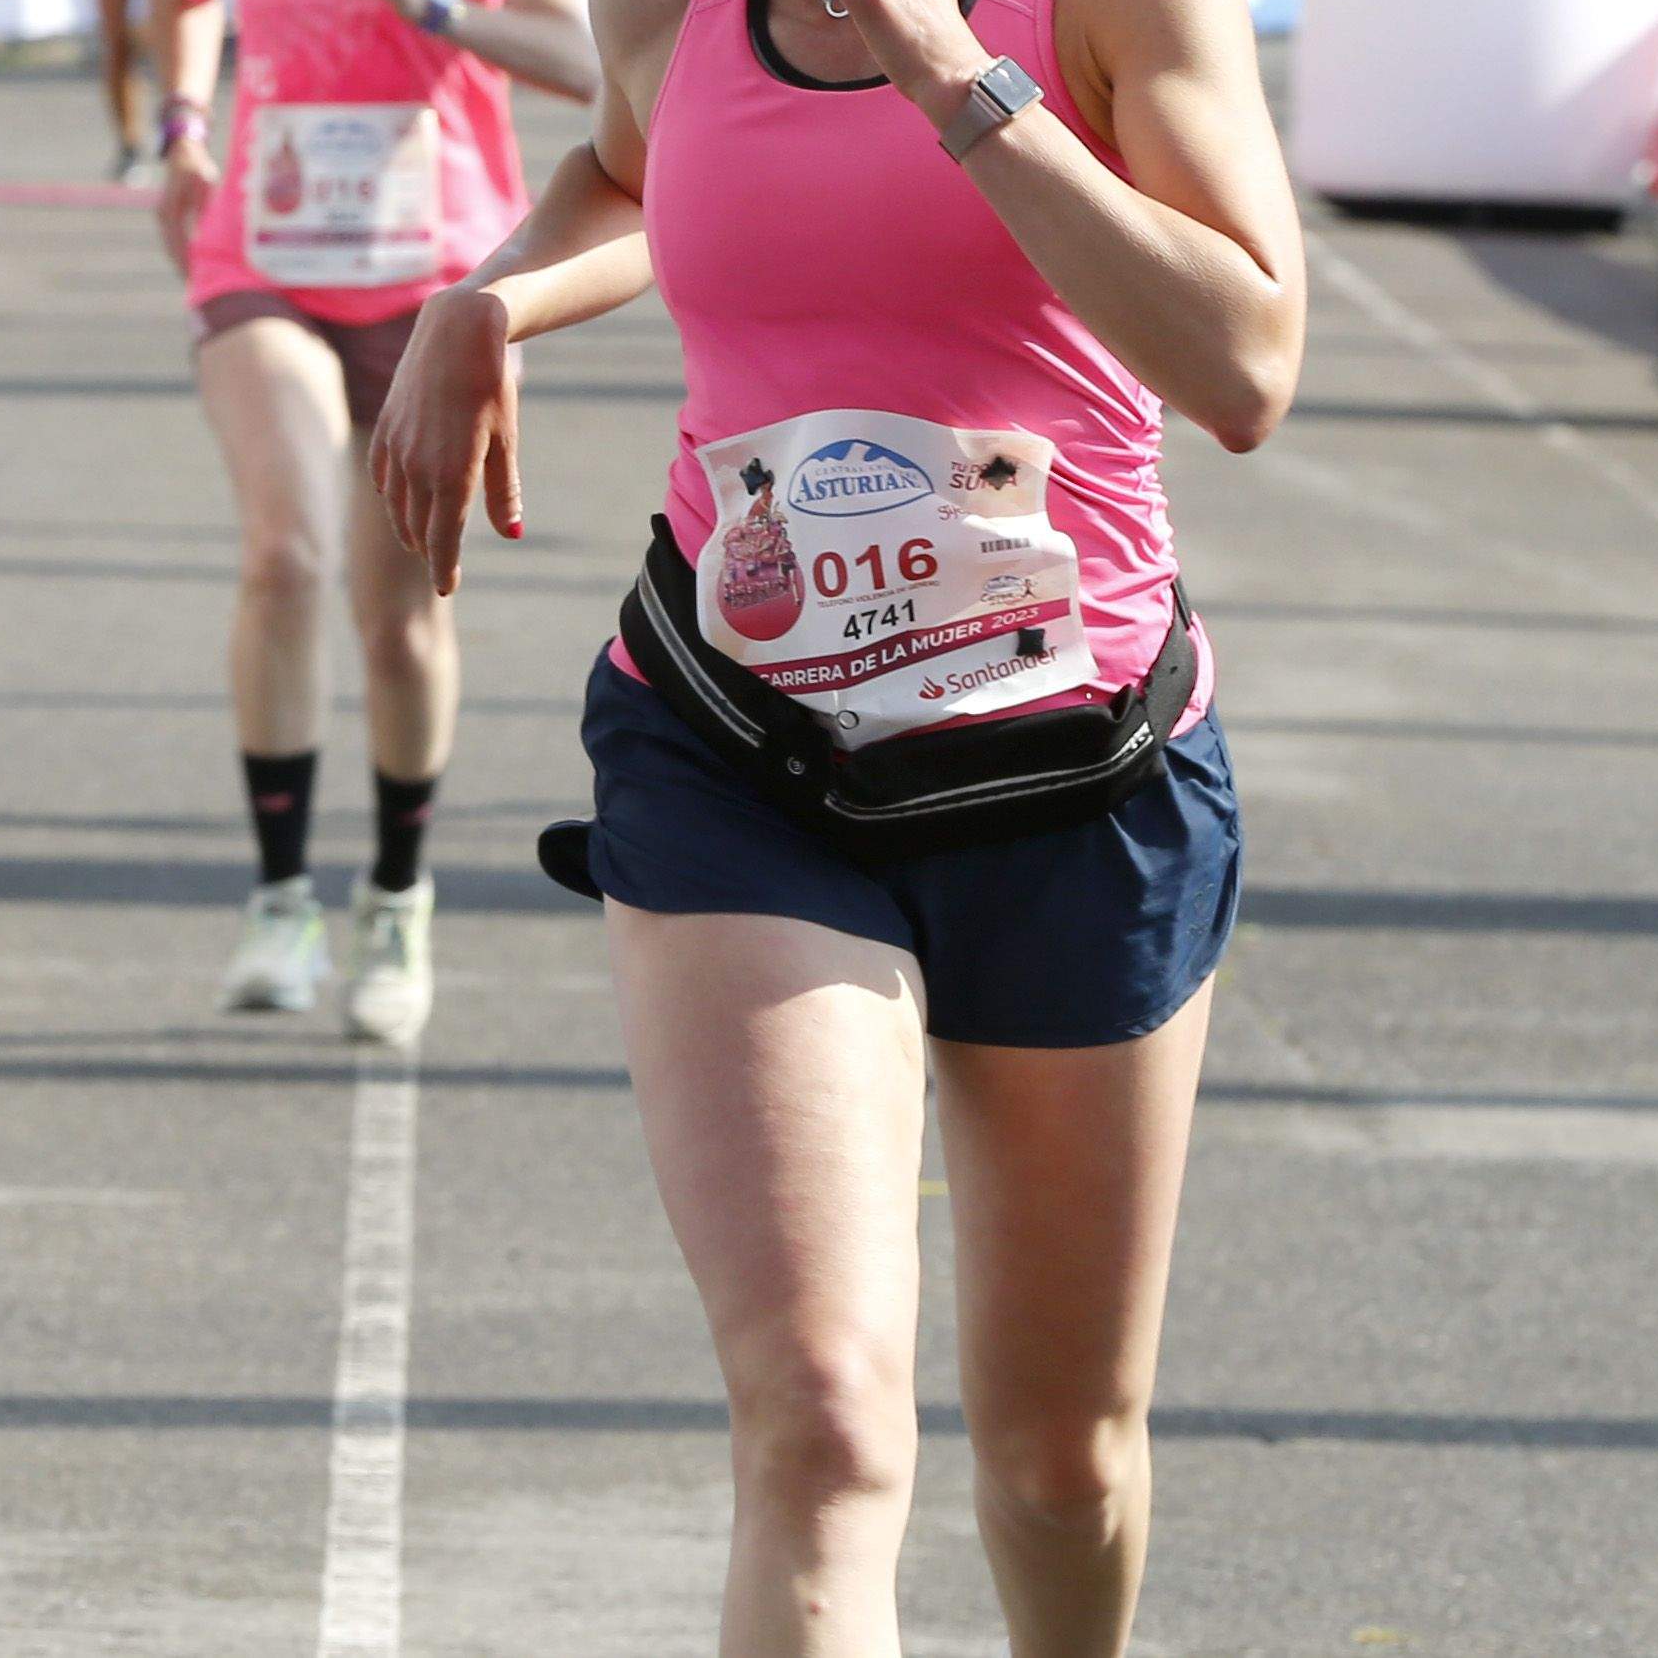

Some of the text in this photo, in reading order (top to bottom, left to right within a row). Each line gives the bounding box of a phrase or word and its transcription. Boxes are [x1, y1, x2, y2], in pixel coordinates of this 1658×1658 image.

[813, 538, 938, 598] 016
[843, 599, 916, 640] 4741
[851, 653, 877, 676] DE
[882, 643, 907, 664] LA
[911, 621, 983, 654] MUJER
